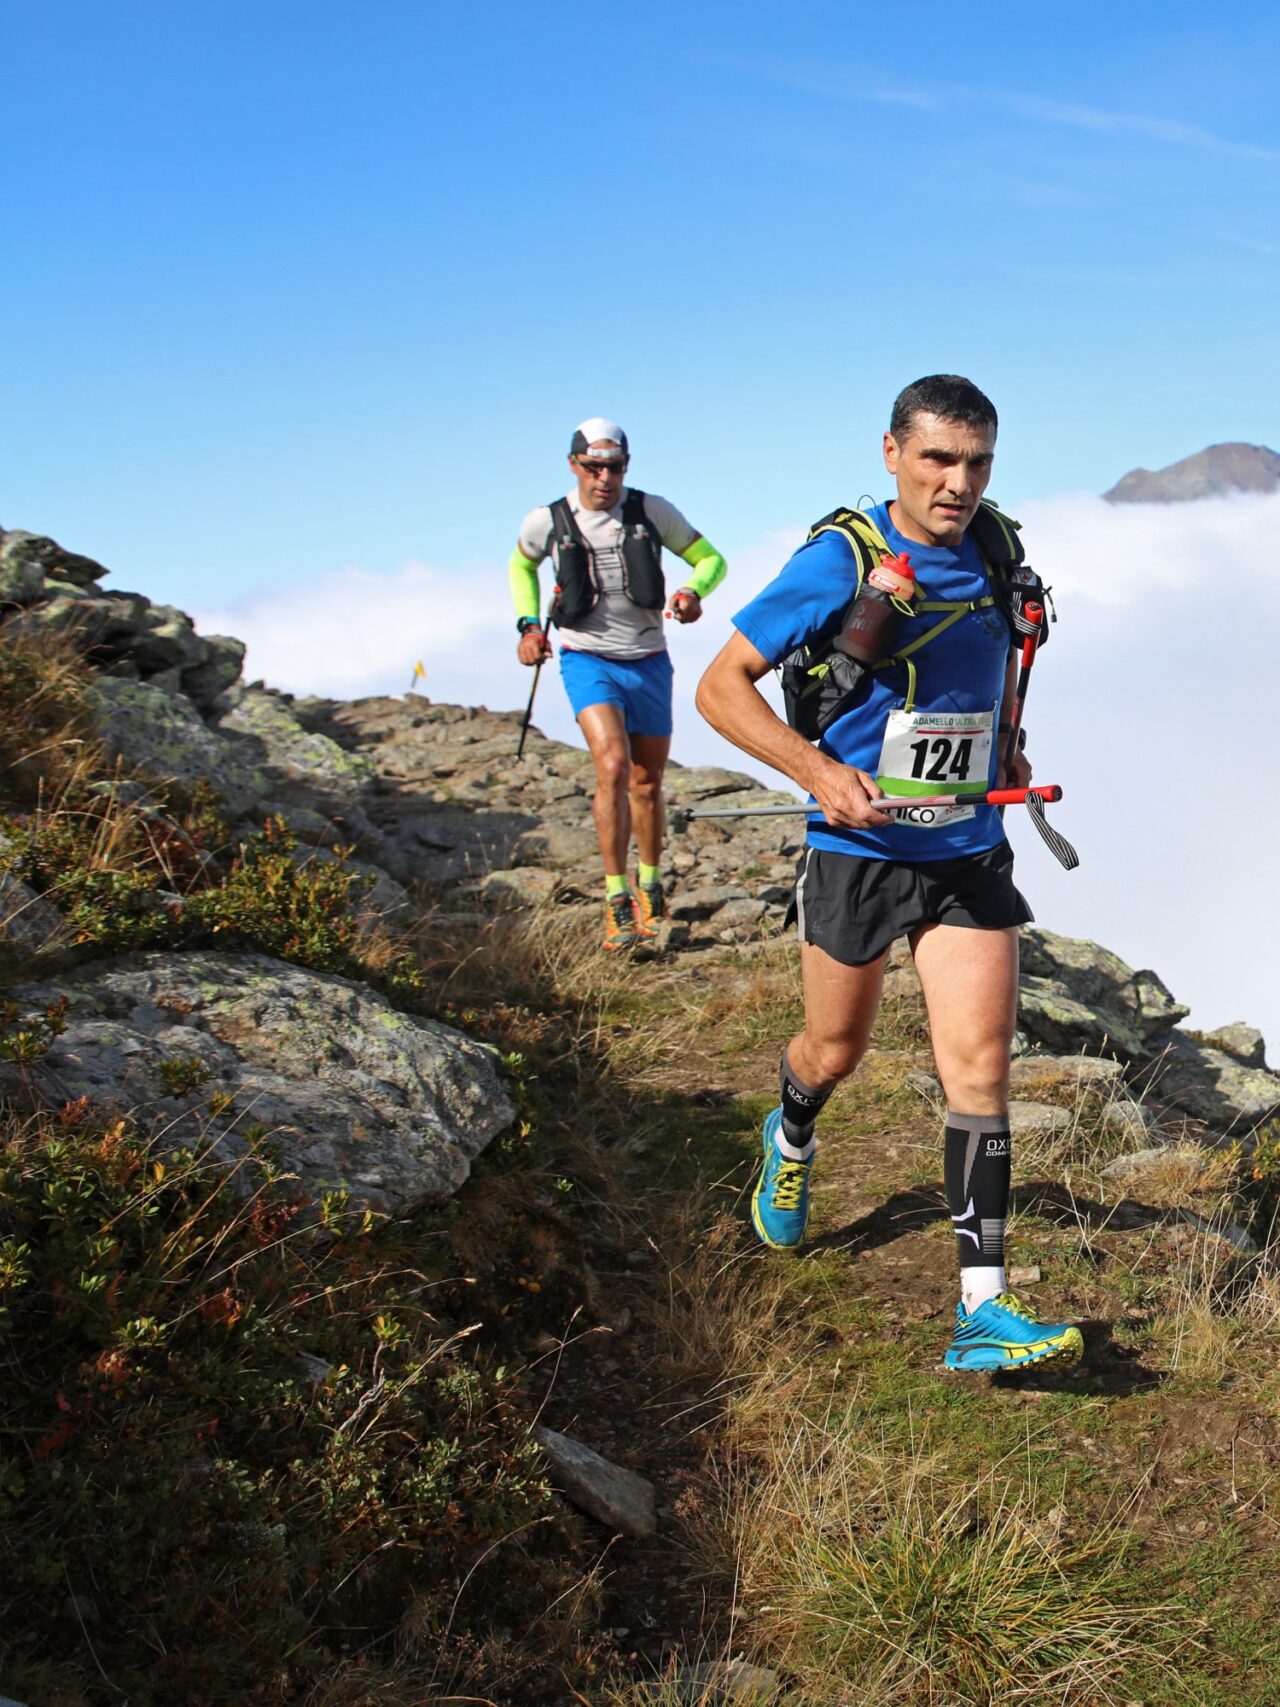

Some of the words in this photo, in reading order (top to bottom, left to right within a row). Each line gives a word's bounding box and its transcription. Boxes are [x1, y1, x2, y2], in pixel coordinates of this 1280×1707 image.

[913, 717, 954, 727] ADAMELLO
[955, 717, 977, 726] ULTRA
[910, 738, 973, 781] 124
